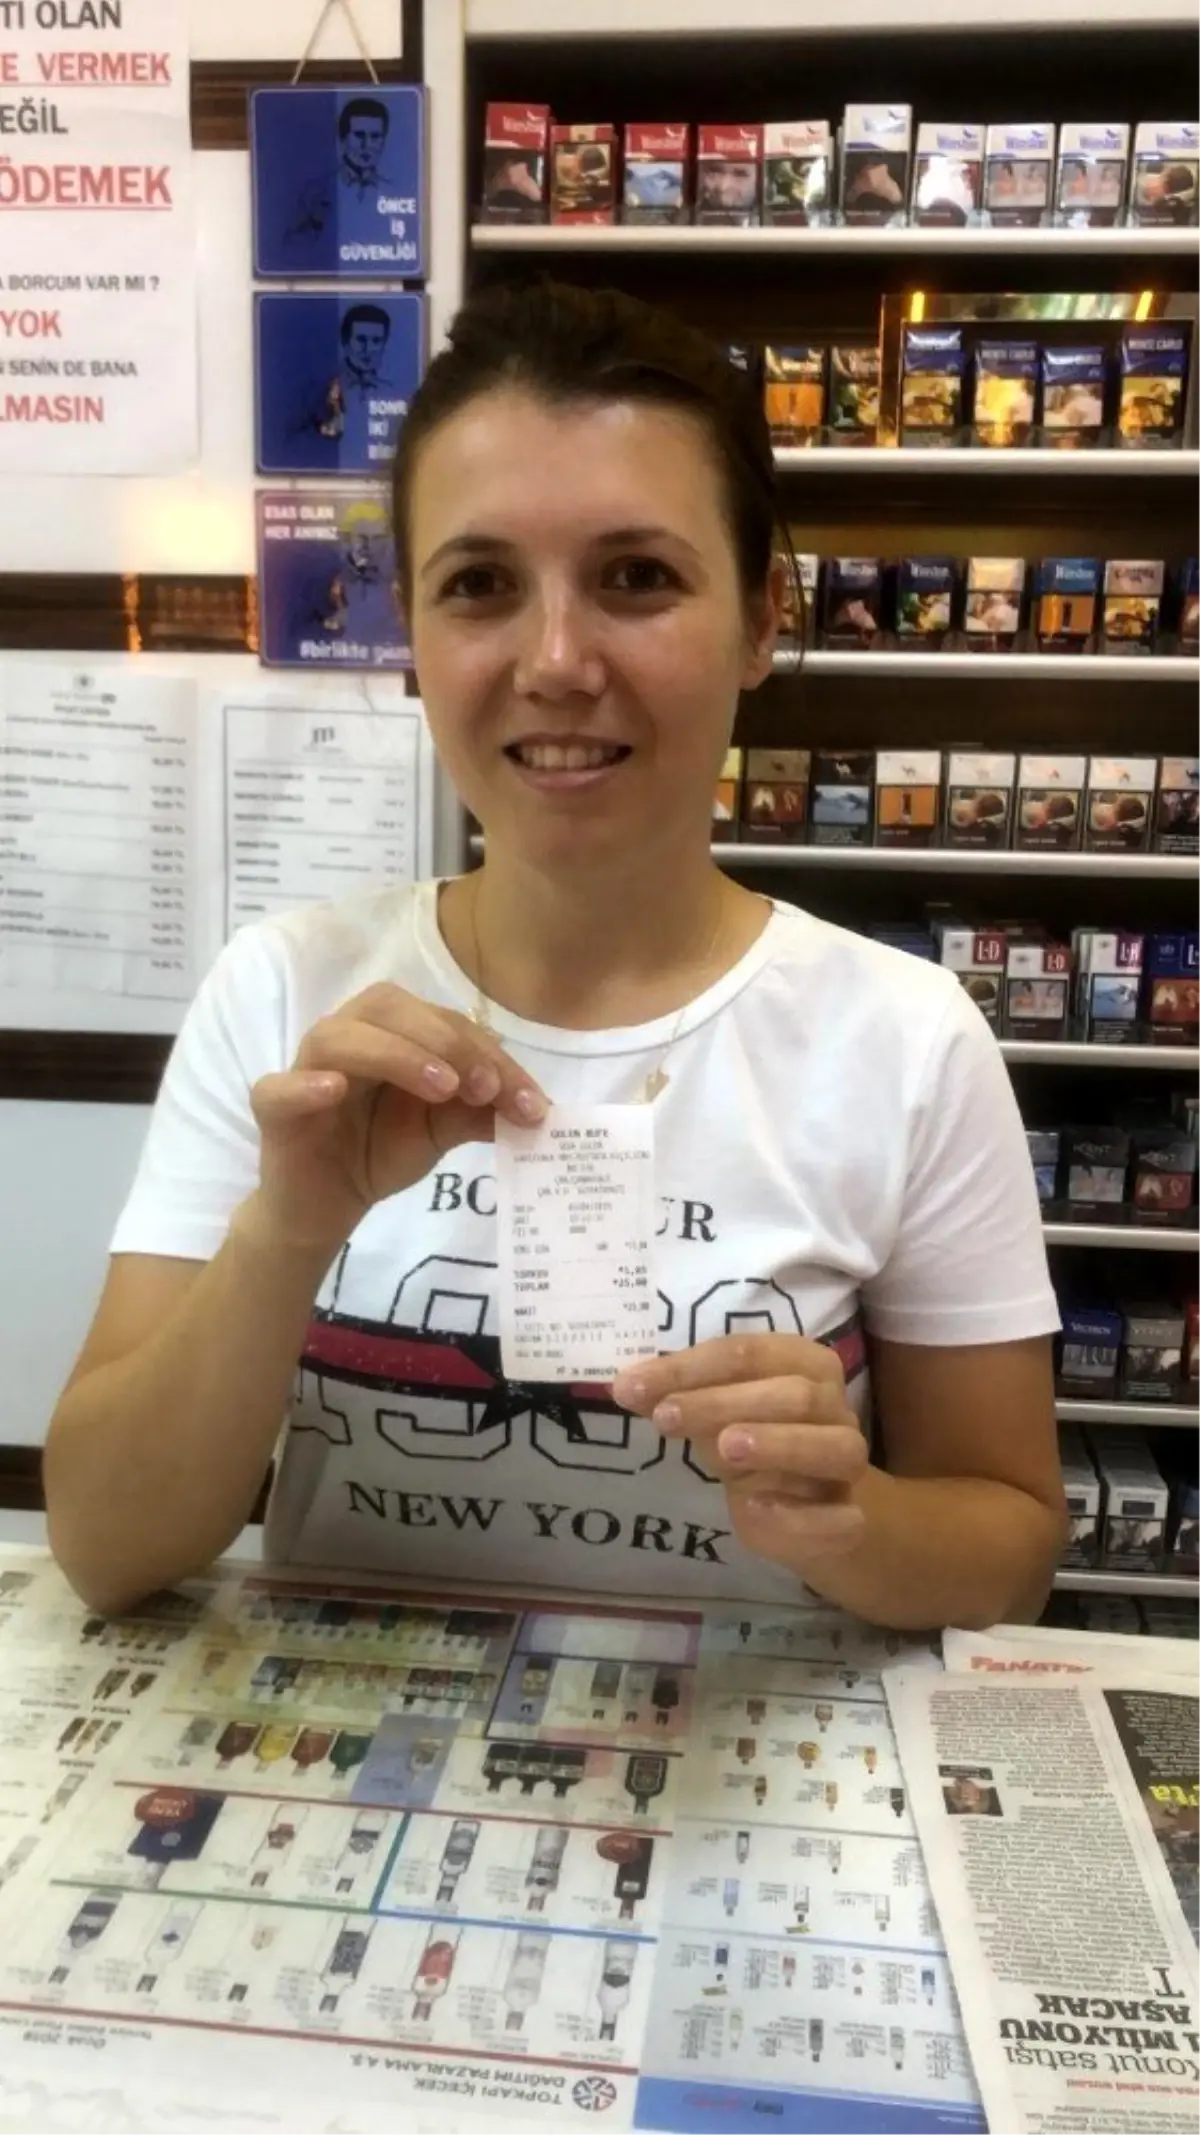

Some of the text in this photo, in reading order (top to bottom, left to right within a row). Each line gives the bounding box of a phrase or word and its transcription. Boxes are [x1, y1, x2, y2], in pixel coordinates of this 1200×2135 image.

[35, 0, 122, 29] OLAN
[37, 53, 171, 82] VERMEK
[0, 156, 172, 205] ÖDEMEK
[377, 196, 417, 215] ÖNCE
[8, 275, 81, 291] BORCUM
[86, 275, 120, 291] VAR
[0, 309, 62, 338] YOK
[9, 357, 59, 376] SENİN
[63, 360, 87, 376] DE
[91, 360, 138, 377] BANA
[0, 393, 105, 422] MASIN
[343, 1480, 733, 1566] NEW YORK
[1034, 1993, 1192, 2025] AŞACAK
[1000, 2018, 1181, 2054] MİLYONU
[383, 2058, 490, 2081] PAZARLAMA
[1003, 2040, 1098, 2071] satışı
[480, 2087, 563, 2105] TOPKAPI
